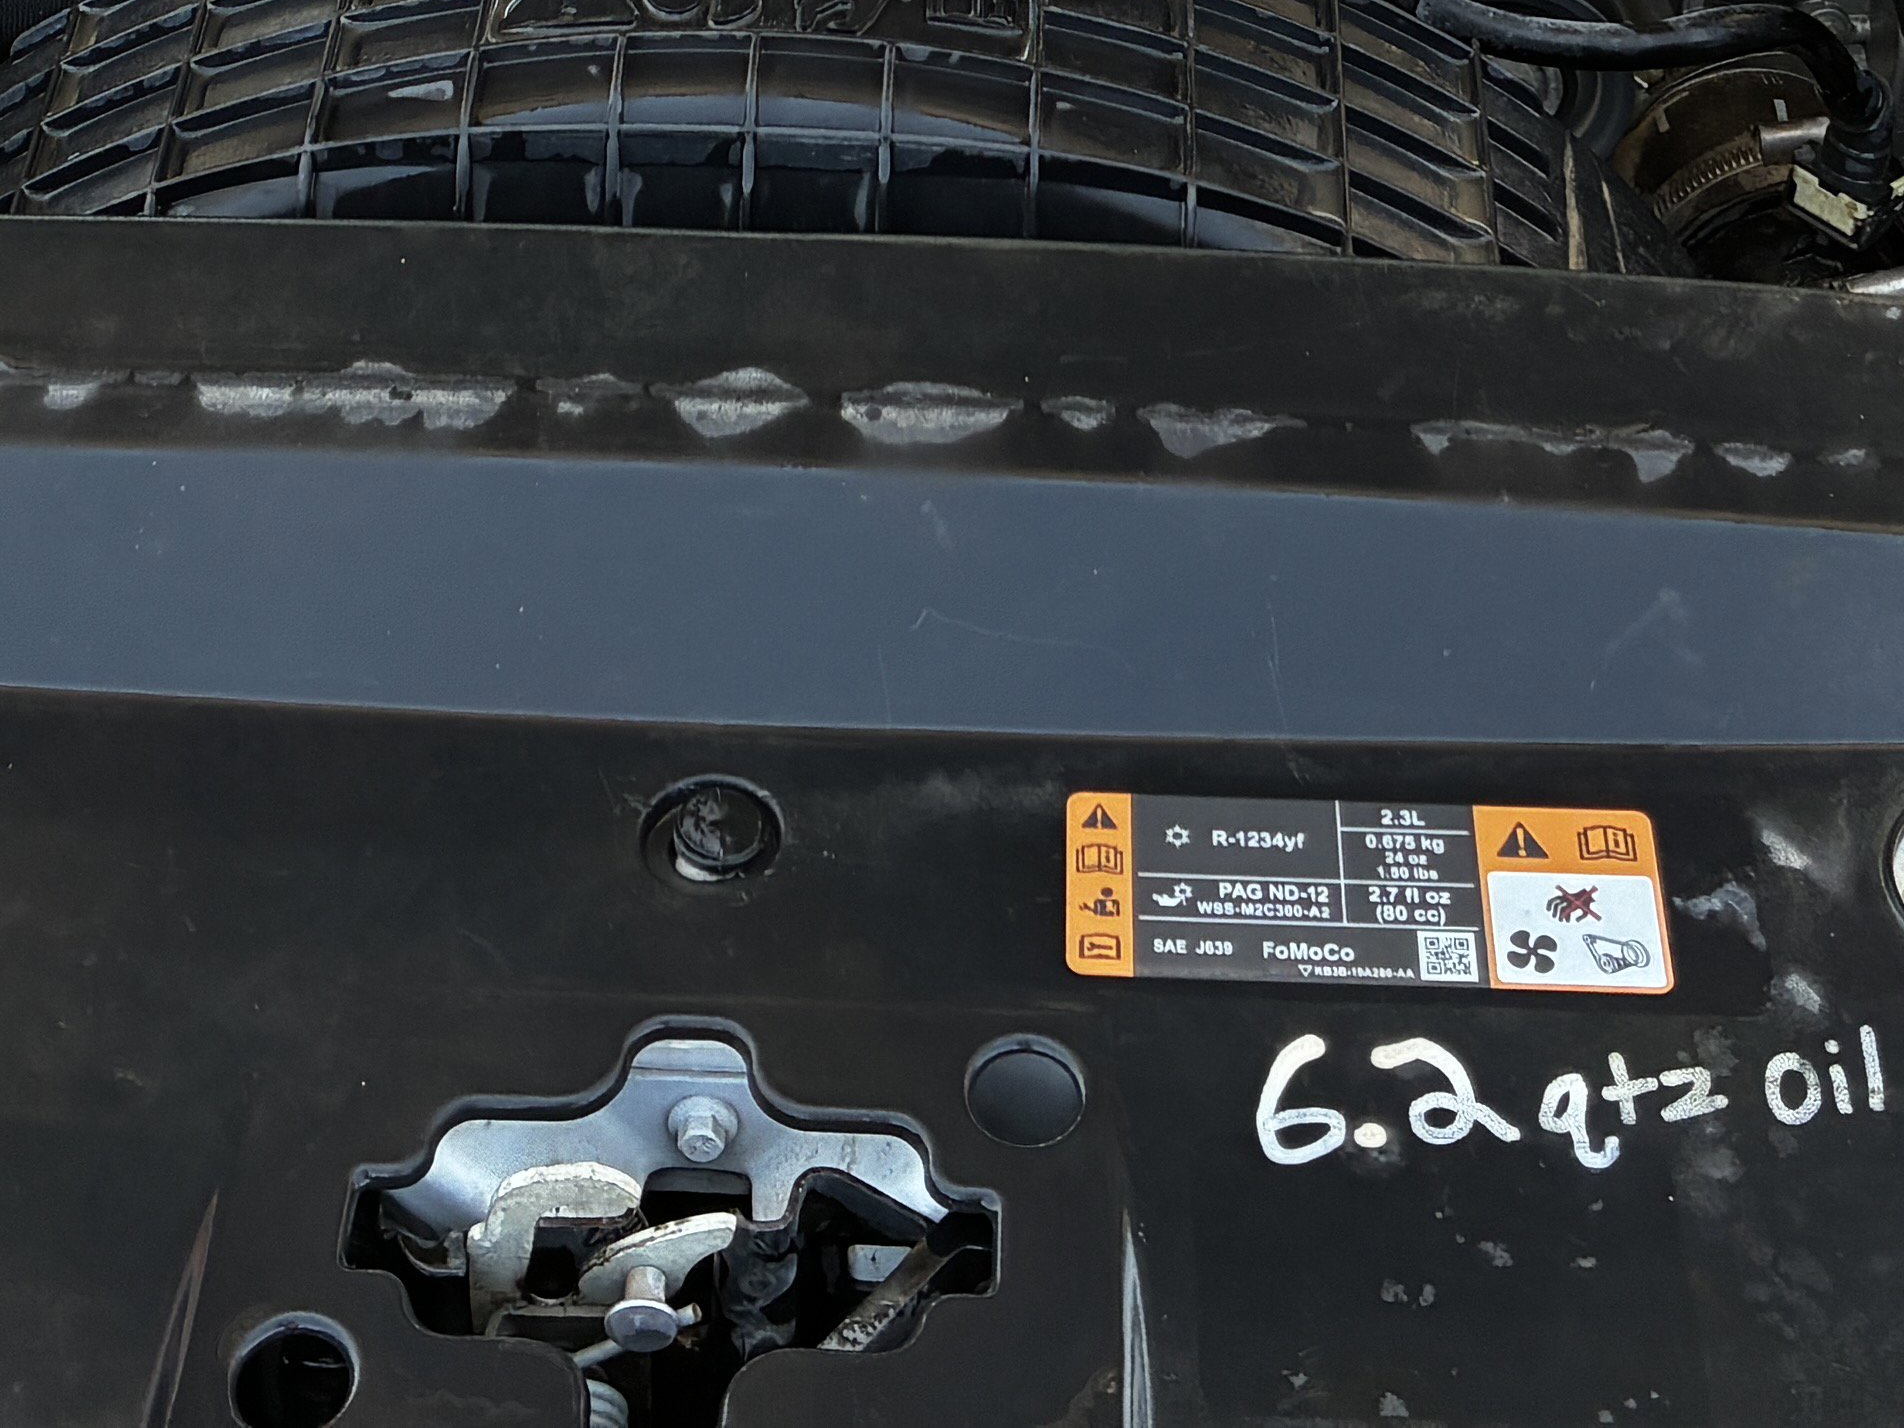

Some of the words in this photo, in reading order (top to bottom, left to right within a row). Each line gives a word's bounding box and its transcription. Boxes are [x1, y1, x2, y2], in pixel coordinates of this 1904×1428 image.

[1380, 809, 1426, 826] 2.3L
[1212, 829, 1305, 853] R-1234yf
[1365, 834, 1416, 850] 0.675
[1421, 836, 1444, 854] kg
[1385, 851, 1404, 864] 24
[1409, 855, 1427, 865] oz
[1414, 867, 1439, 880] lbs
[1219, 882, 1263, 900] PAG
[1269, 885, 1330, 903] ND-12
[1368, 887, 1399, 903] 2.7
[1405, 888, 1419, 903] fl
[1425, 892, 1451, 904] oz
[1197, 901, 1330, 918] WSS-M2C300-A2
[1376, 904, 1408, 924] (80
[1414, 906, 1447, 927] cc)
[1153, 938, 1188, 954] SAE
[1195, 940, 1233, 956] J639
[1262, 941, 1355, 962] FoMoCo
[1254, 1033, 1521, 1166] 6.2
